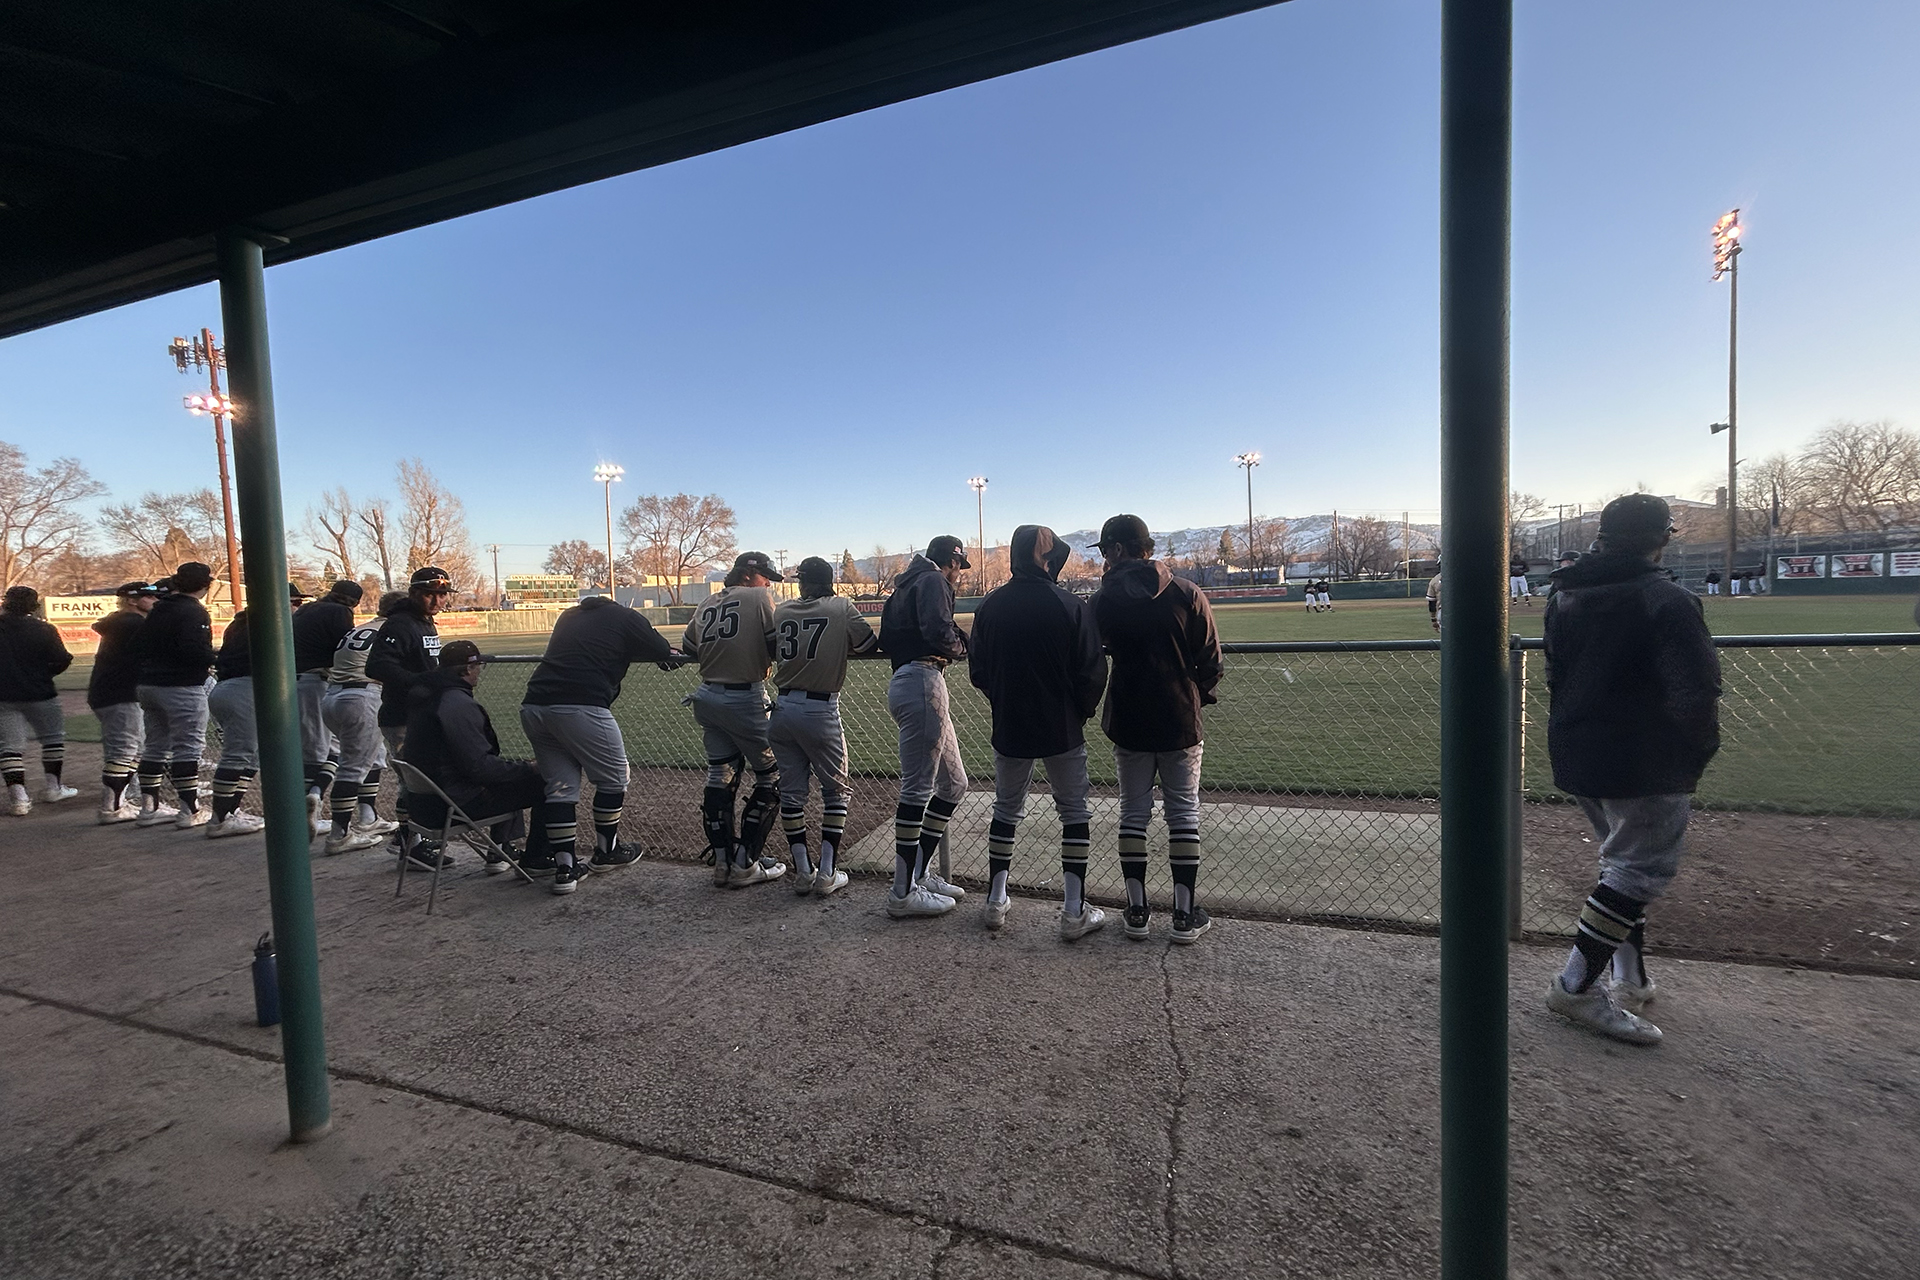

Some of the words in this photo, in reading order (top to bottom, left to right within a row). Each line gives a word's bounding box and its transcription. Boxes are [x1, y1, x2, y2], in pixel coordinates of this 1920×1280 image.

[52, 602, 103, 612] FRANK
[857, 603, 884, 613] OUGS
[701, 601, 741, 643] 25
[779, 617, 830, 660] 37
